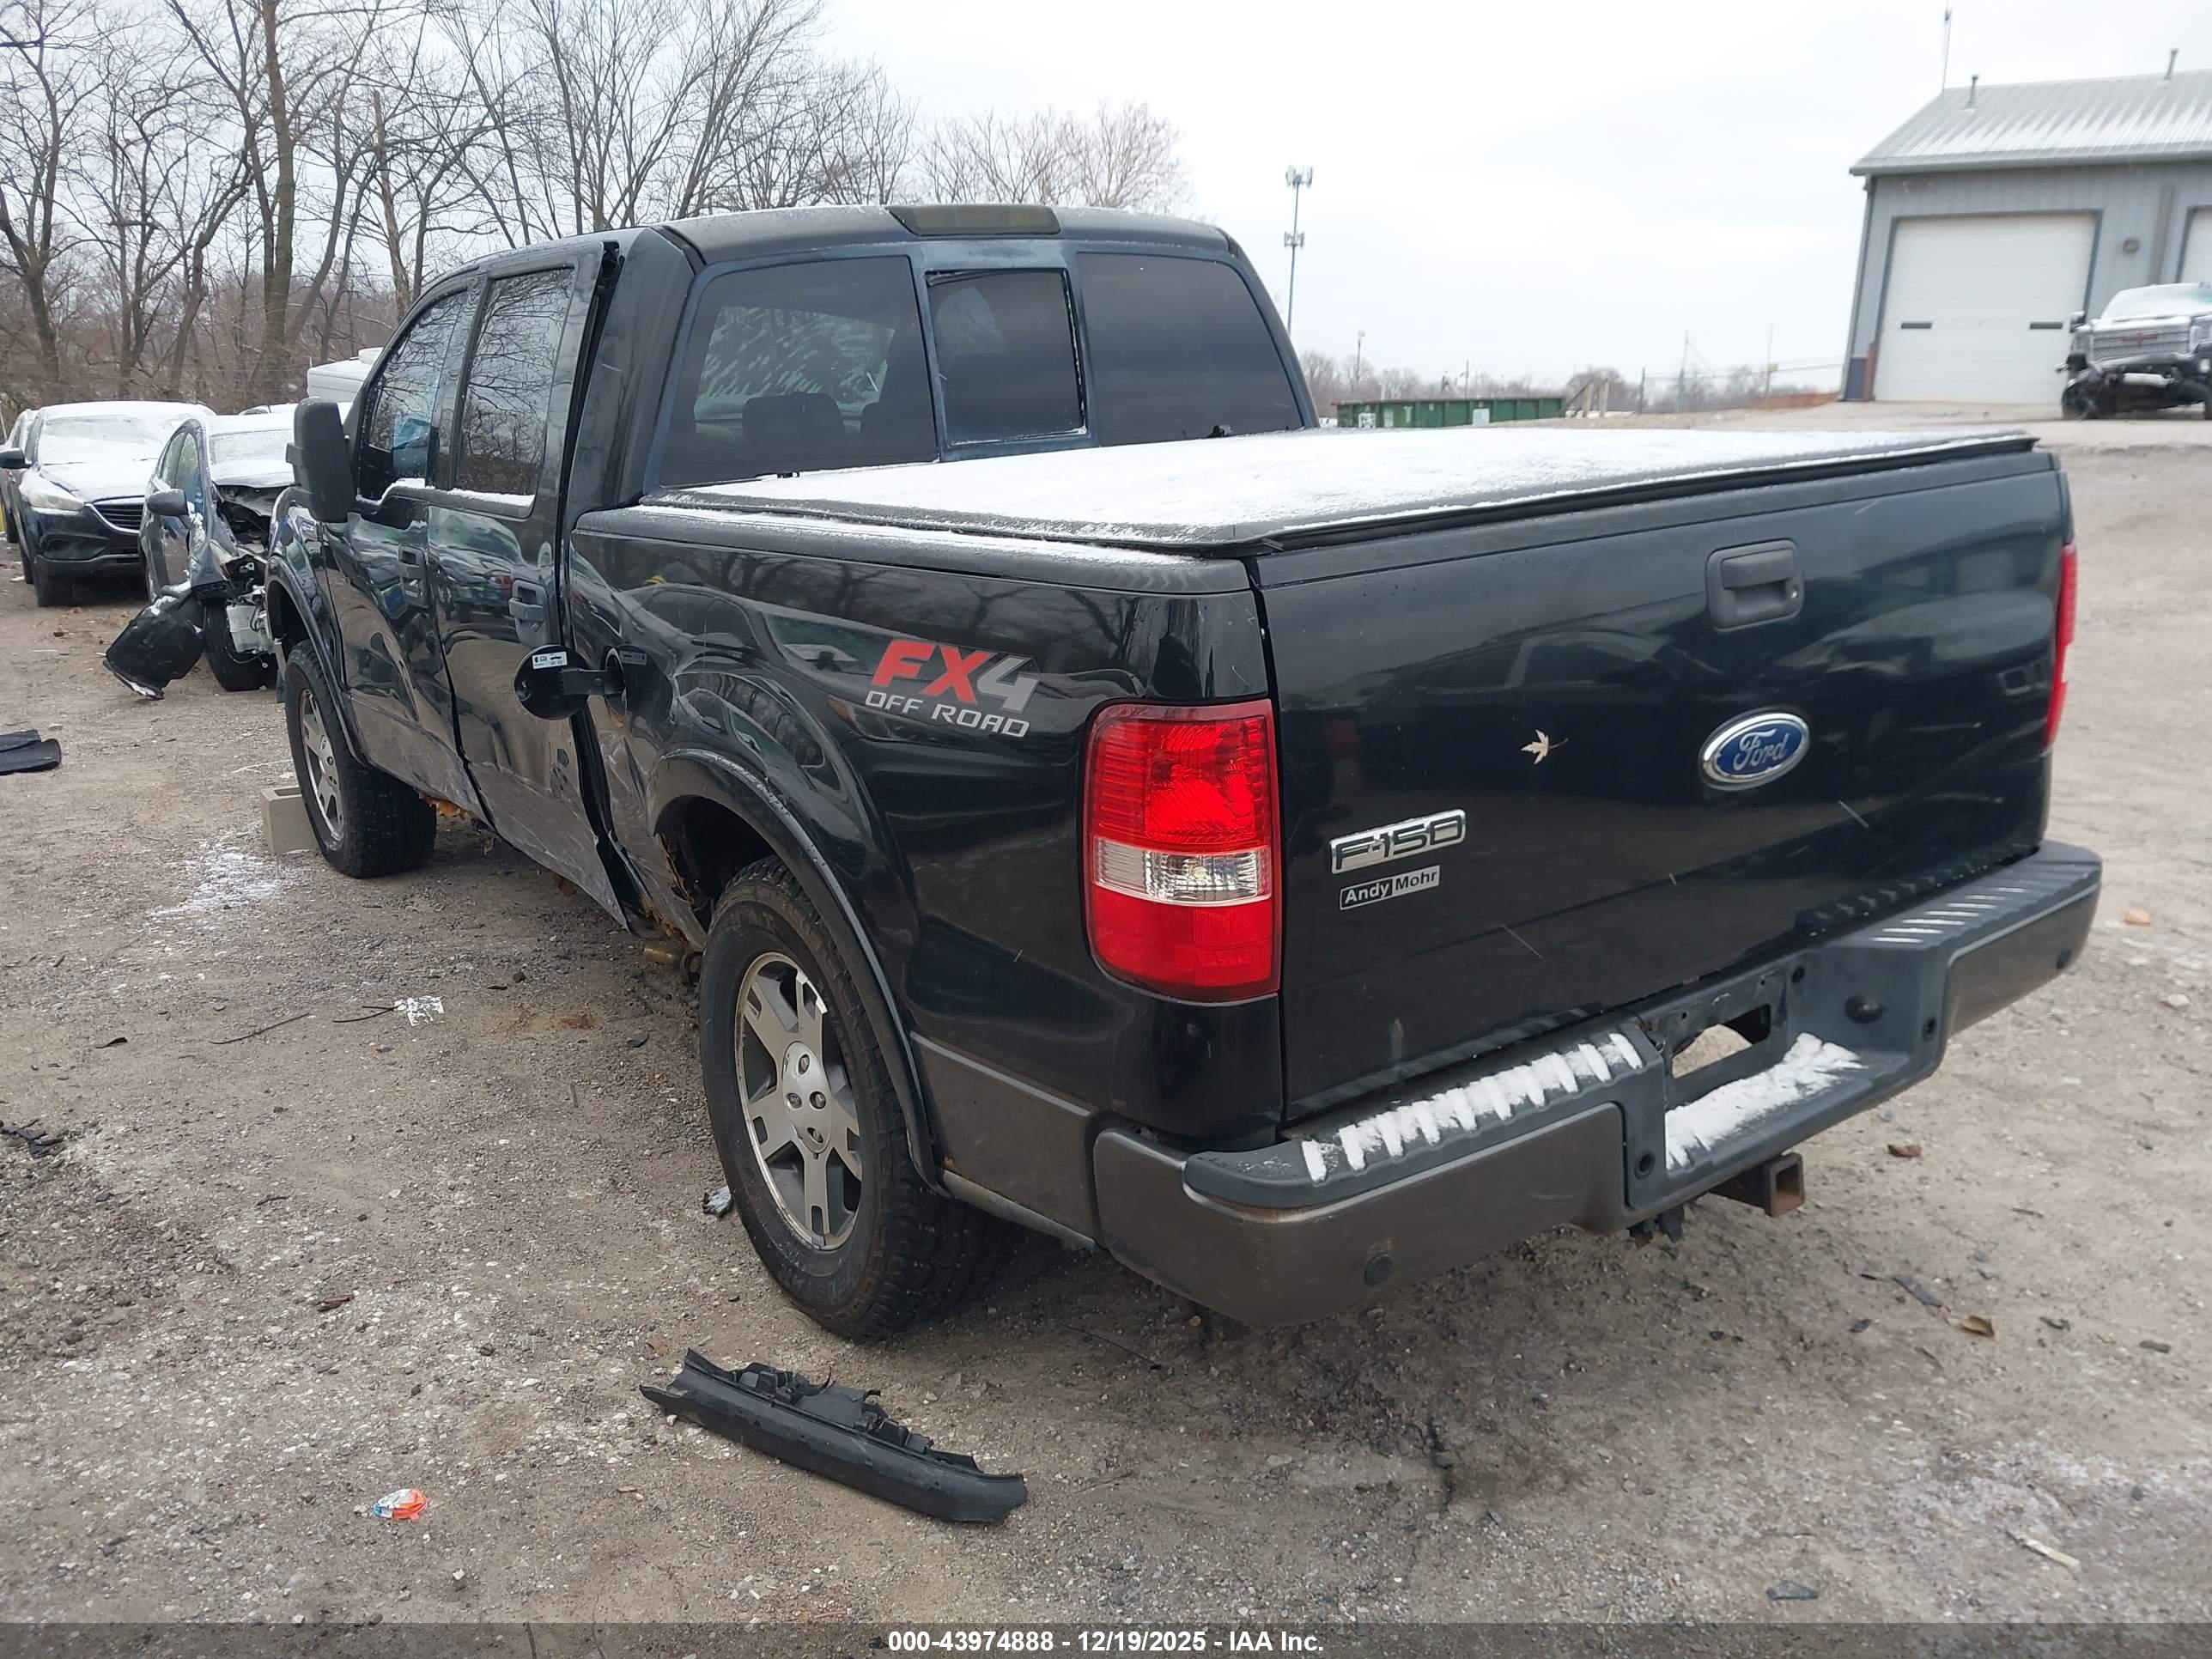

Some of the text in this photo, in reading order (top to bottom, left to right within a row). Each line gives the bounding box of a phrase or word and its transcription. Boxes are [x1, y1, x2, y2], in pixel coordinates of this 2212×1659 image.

[870, 638, 1041, 714] FX4
[865, 690, 1030, 738] OFF ROAD
[1732, 728, 1790, 771] Ford
[1333, 813, 1463, 872] F-150
[1344, 869, 1438, 903] Andy Mohr
